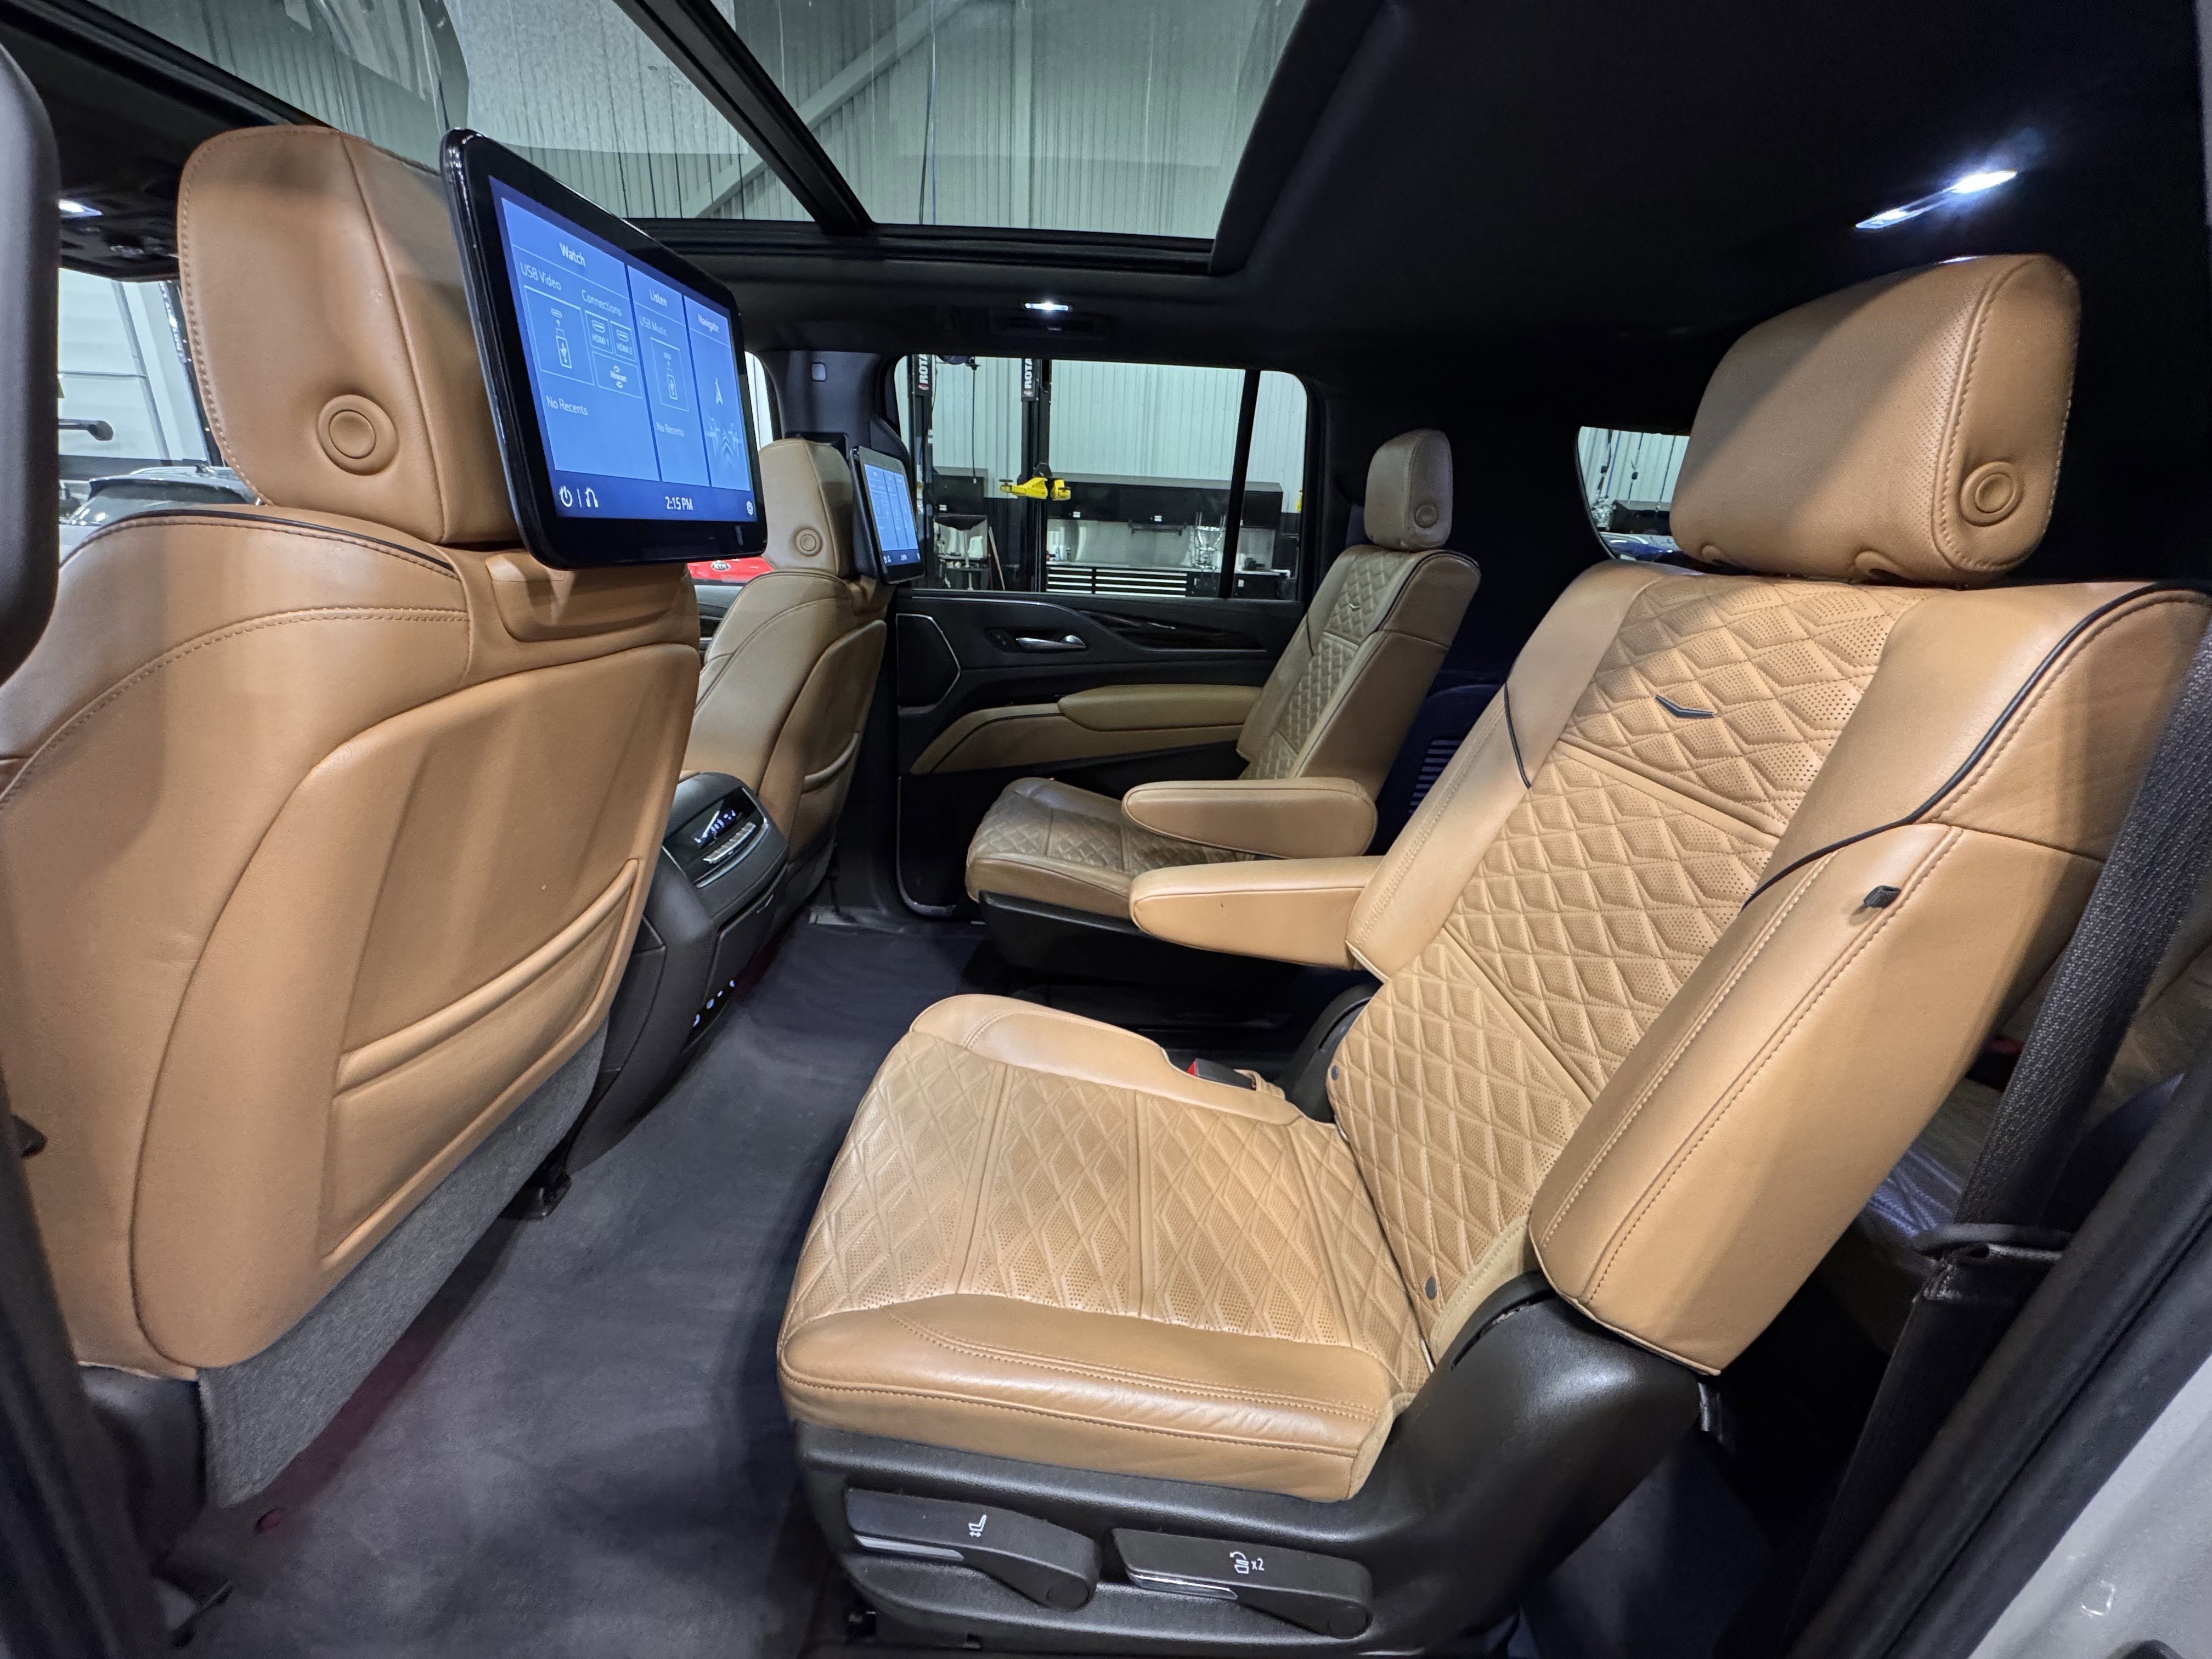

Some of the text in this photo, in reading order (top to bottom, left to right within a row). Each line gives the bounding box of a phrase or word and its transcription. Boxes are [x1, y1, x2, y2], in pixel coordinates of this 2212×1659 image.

[559, 242, 586, 267] Watch
[520, 262, 562, 290] USB Video
[582, 290, 622, 317] Connections
[649, 289, 668, 307] Listen
[639, 315, 668, 336] USB Music
[697, 313, 719, 333] Navigate
[591, 333, 606, 345] HDMI
[616, 342, 629, 353] HDMI
[546, 395, 589, 416] No Recents
[656, 421, 685, 437] No Recents
[665, 496, 694, 511] 2:15 PM
[1251, 1558, 1265, 1572] x2
